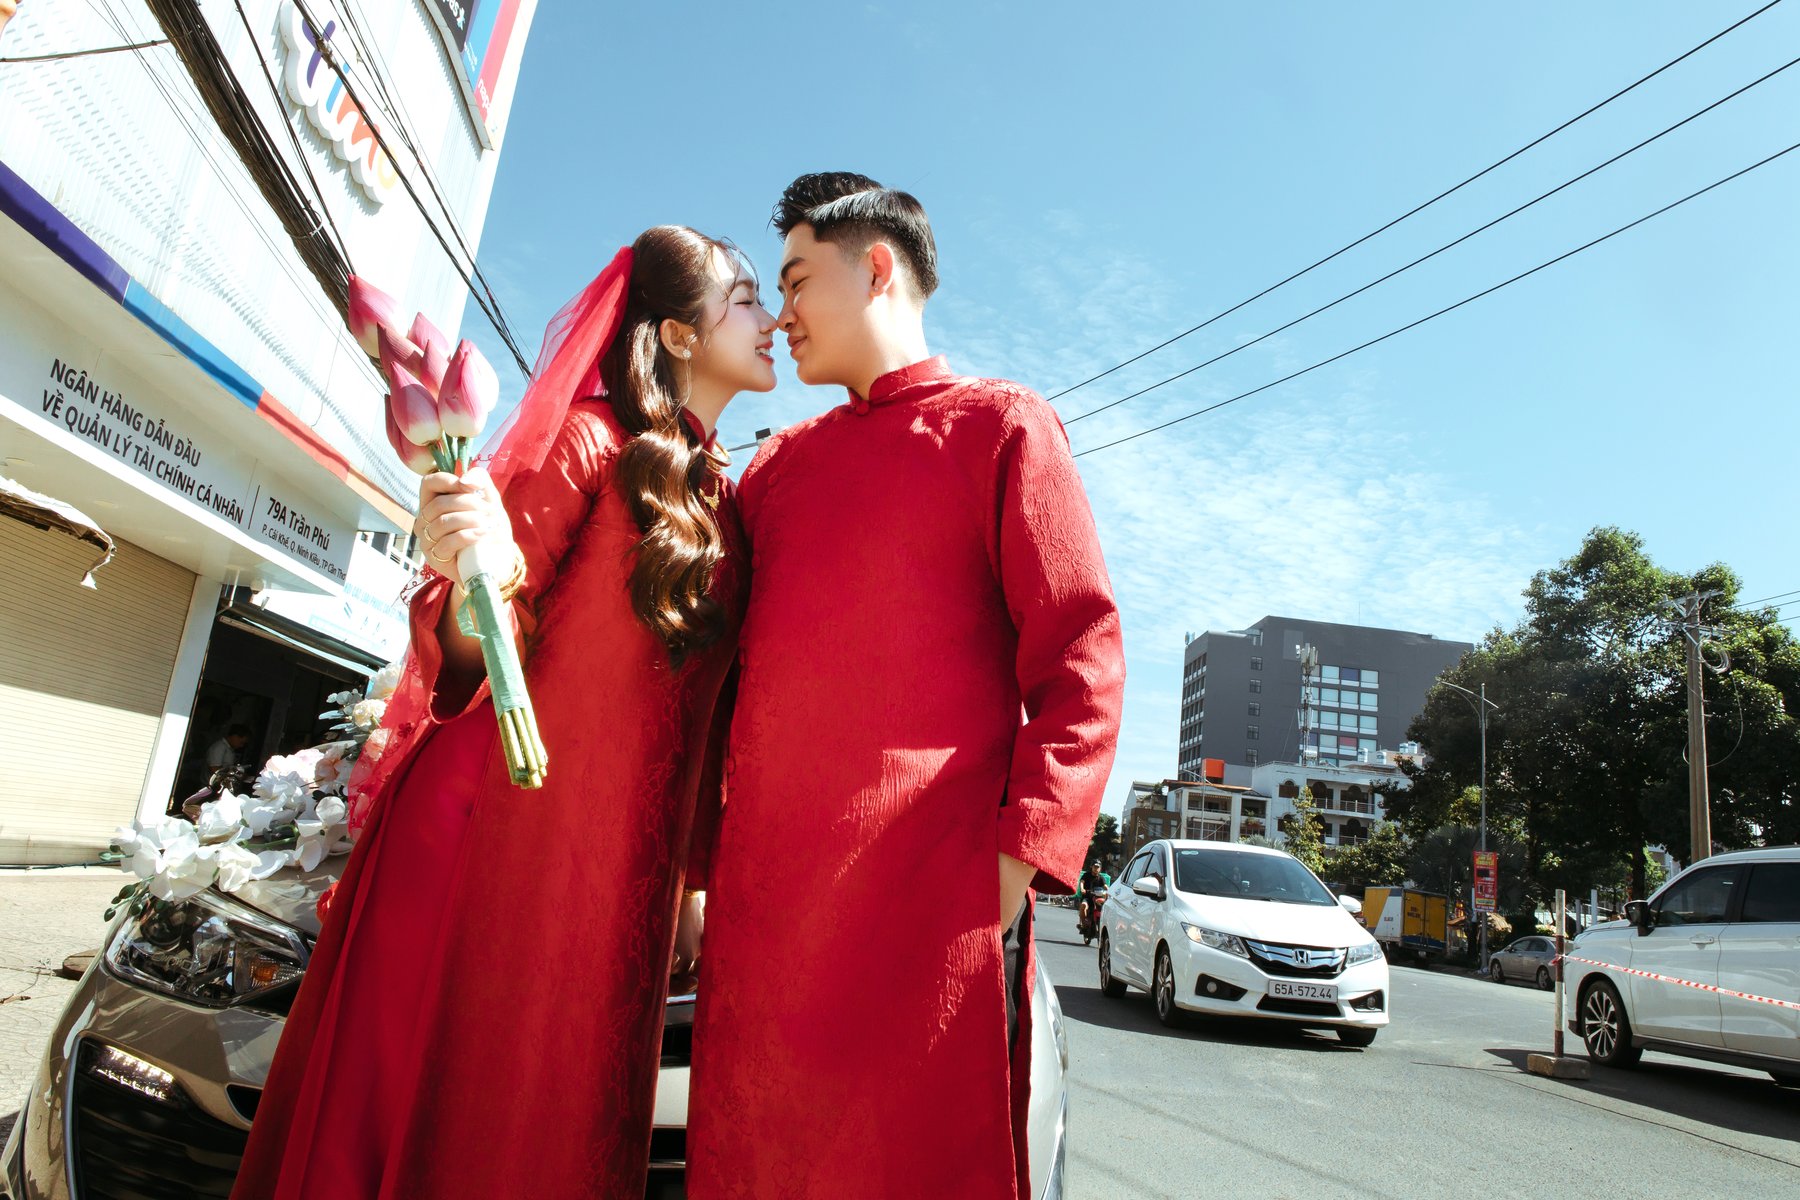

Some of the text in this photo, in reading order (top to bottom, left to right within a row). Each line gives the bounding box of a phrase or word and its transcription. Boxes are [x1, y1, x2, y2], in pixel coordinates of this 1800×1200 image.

[50, 358, 201, 467] NGÂN HÀNG DẪN ĐẦU
[42, 388, 244, 524] VỀ QUẢN LÝ TÀI CHÍNH CÁ NHÂN
[267, 496, 331, 551] 79A Trần Phú
[290, 541, 296, 553] Q.
[1274, 983, 1332, 999] 65A-572.44
